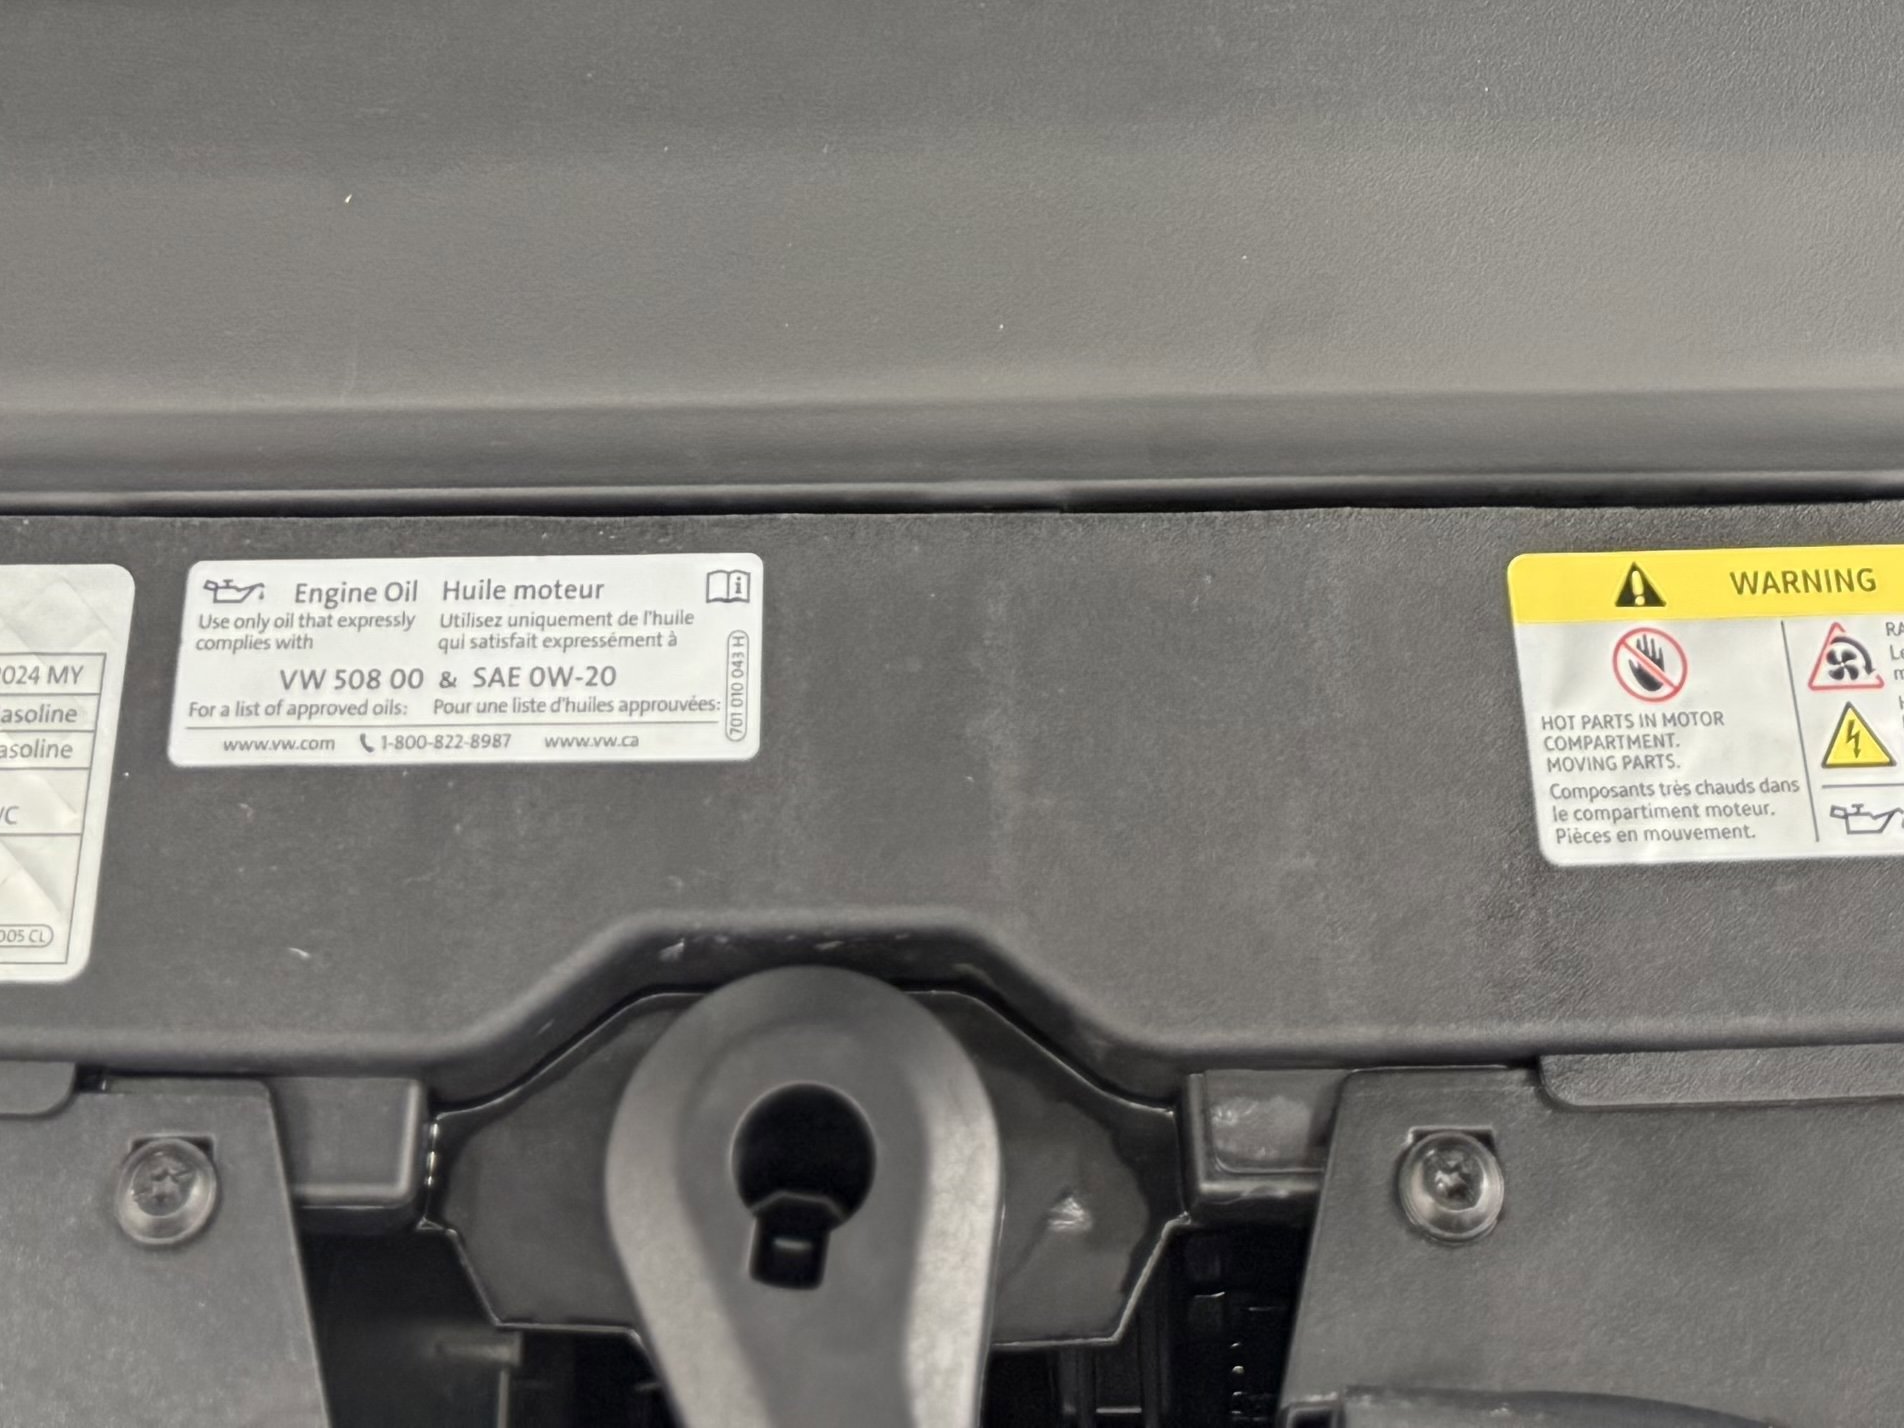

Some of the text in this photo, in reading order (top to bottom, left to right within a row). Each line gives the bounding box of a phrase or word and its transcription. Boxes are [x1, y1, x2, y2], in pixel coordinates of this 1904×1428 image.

[443, 578, 604, 601] Huile moteur
[1730, 568, 1876, 595] WARNING
[295, 579, 418, 610] Engine Oil
[198, 610, 416, 634] Use only oil that expressly
[440, 609, 694, 632] Utilisez uniquement de l'huile
[195, 633, 313, 655] complies with
[438, 630, 677, 655] qui satisfait expressément à
[47, 665, 84, 685] MY
[280, 666, 616, 690] VW 508 00 & SAE 0W-20
[188, 698, 408, 721] For a list of approved oils:
[433, 695, 721, 717] Pour une liste d'huiles approuvées:
[1541, 711, 1725, 732] HOT PARTS IN MOTOR
[223, 733, 639, 751] www.vw.com 1-800-822-8987 www.vw.ca
[1543, 732, 1680, 752] COMPARTMENT.
[1547, 753, 1680, 773] MOVING PARTS.
[1549, 777, 1800, 800] Composants très chauds dans
[1552, 799, 1775, 825] le compartiment moteur.
[1555, 824, 1756, 844] Pièces en mouvement.
